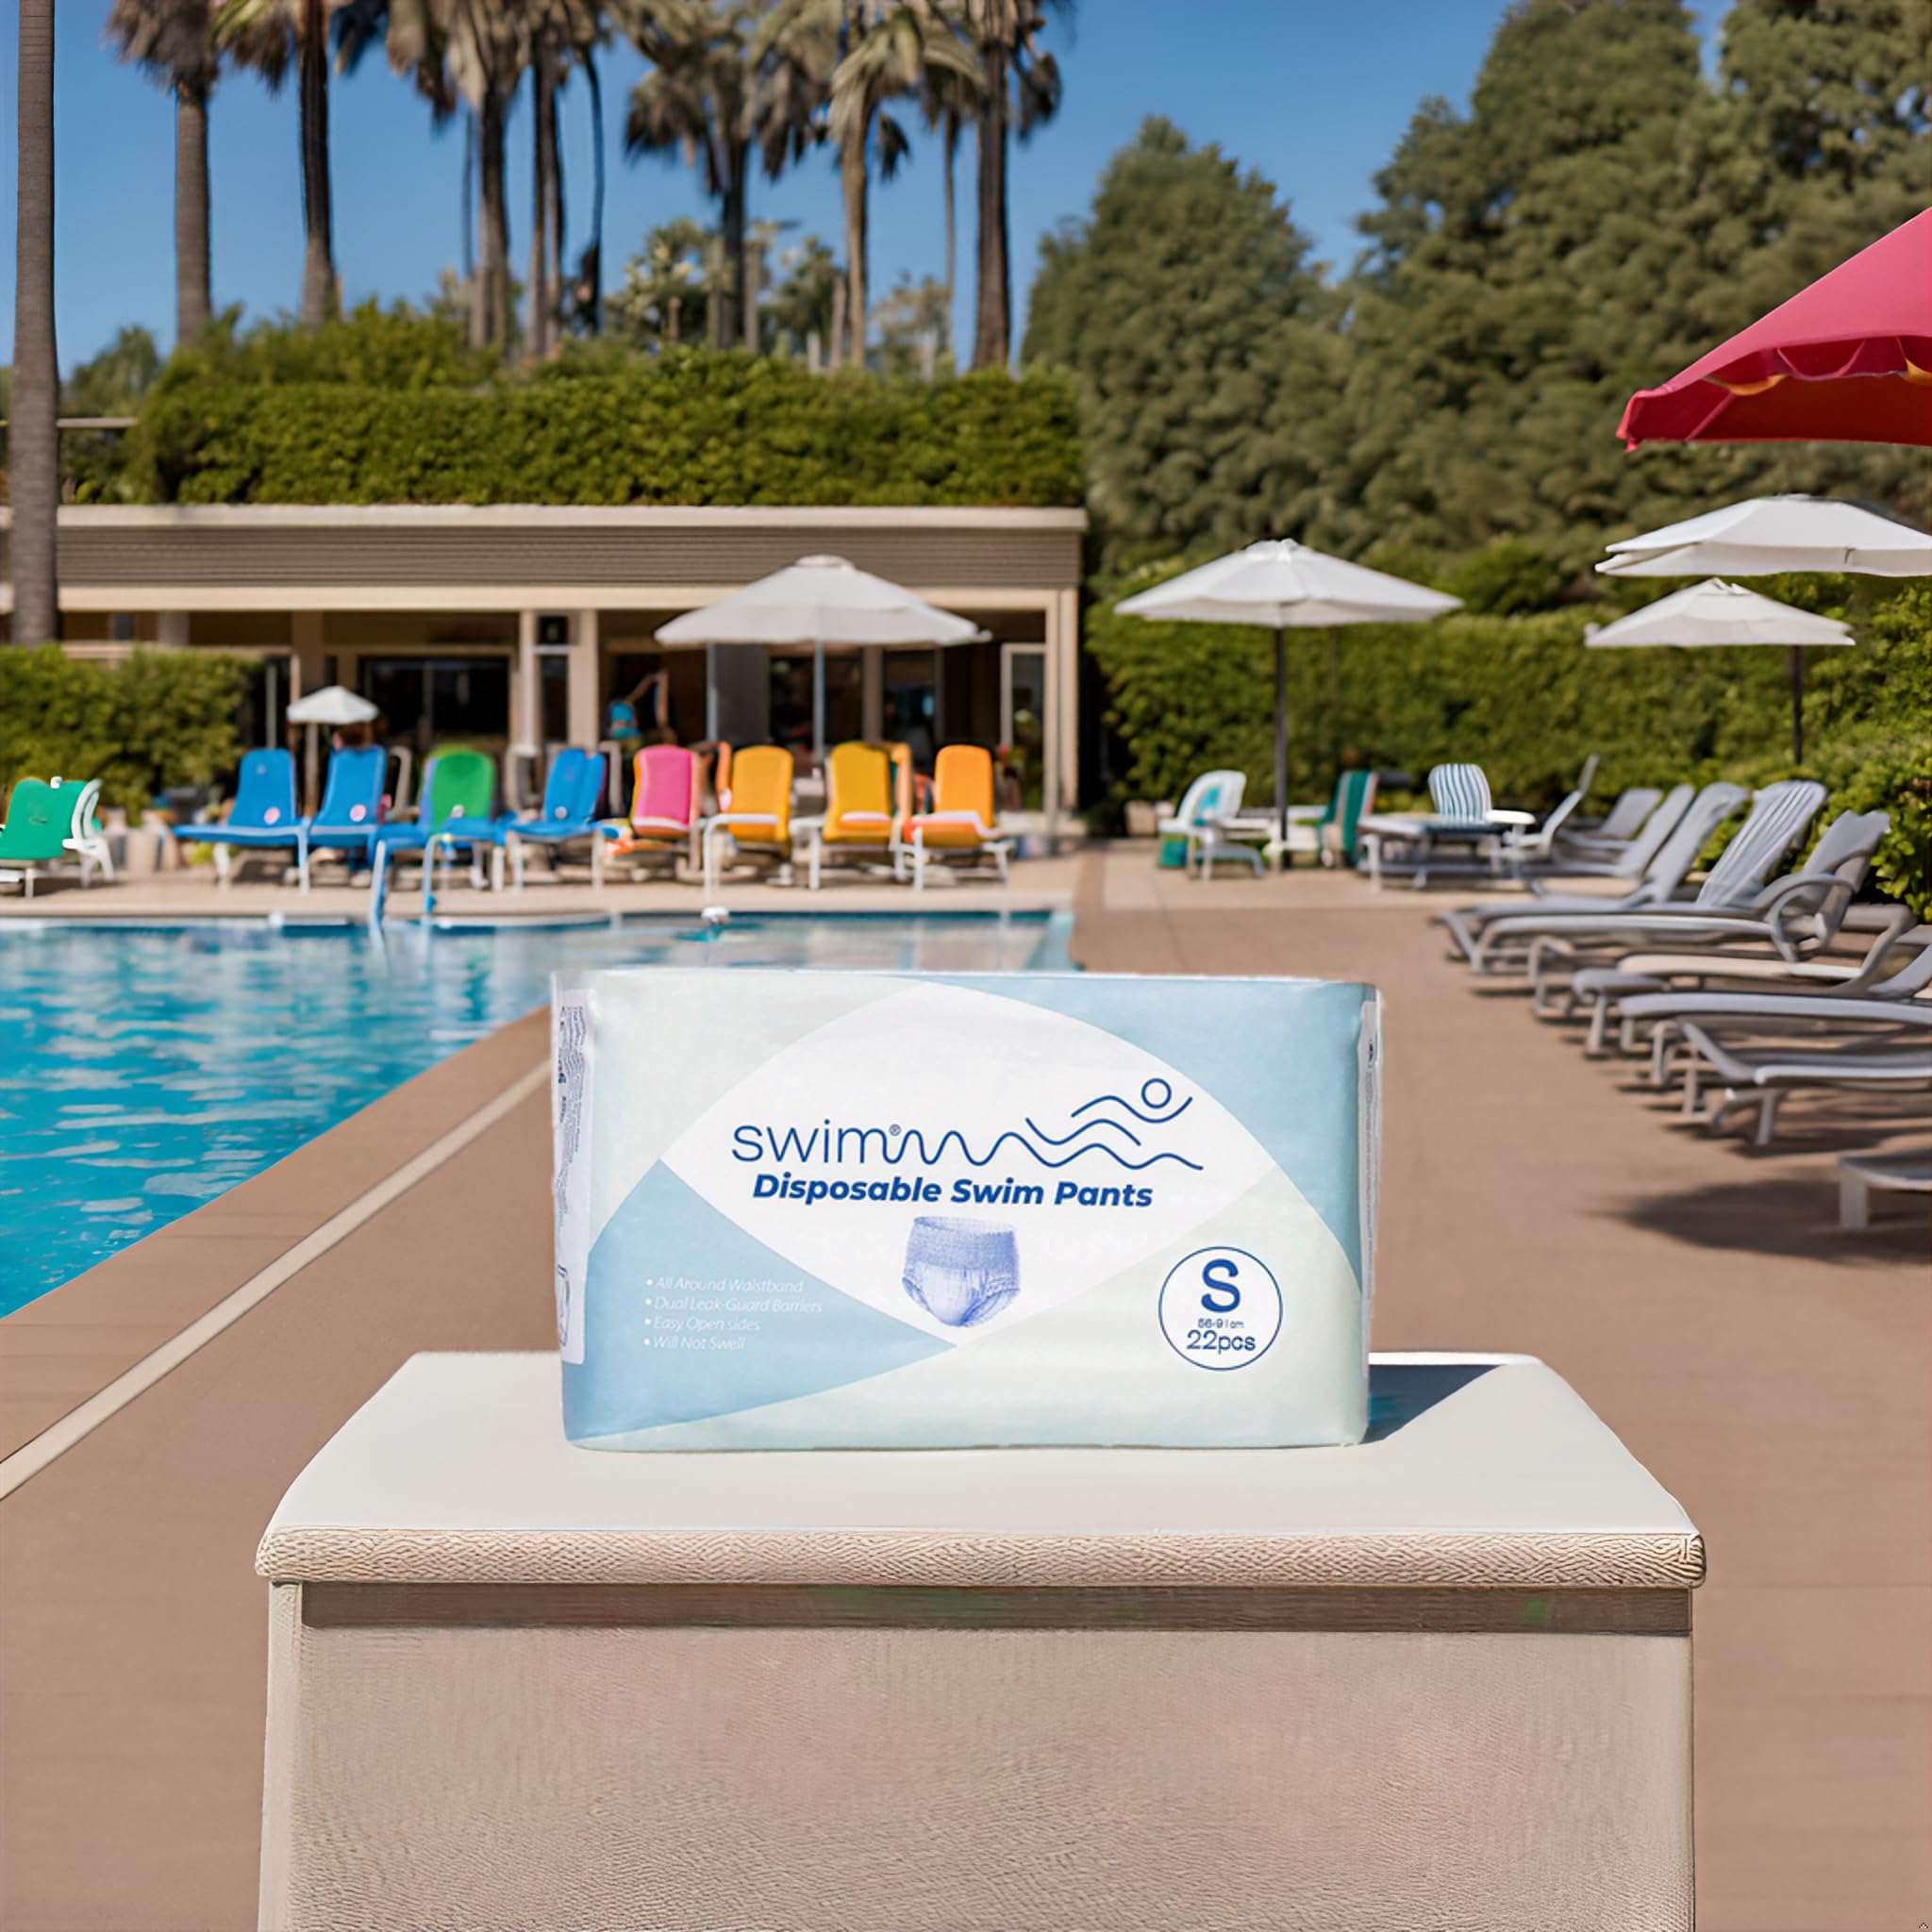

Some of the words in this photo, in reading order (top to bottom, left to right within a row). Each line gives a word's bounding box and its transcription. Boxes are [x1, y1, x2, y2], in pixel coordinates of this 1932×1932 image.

[753, 1173, 941, 1205] Disposable
[950, 1177, 1044, 1205] Swim
[1054, 1181, 1154, 1207] Pants
[655, 1277, 673, 1290] All
[674, 1278, 725, 1291] Around
[728, 1279, 804, 1292] Waistband
[1200, 1258, 1241, 1313] S
[654, 1296, 689, 1310] Dual
[690, 1298, 770, 1312] Leak-Guard
[772, 1300, 823, 1313] Barriers
[654, 1317, 683, 1331] Easy
[686, 1317, 725, 1332] Open
[727, 1318, 760, 1331] sides
[653, 1336, 678, 1349] Will
[680, 1336, 707, 1349] Not
[708, 1336, 746, 1350] Swell
[1186, 1329, 1257, 1355] 22pcs
